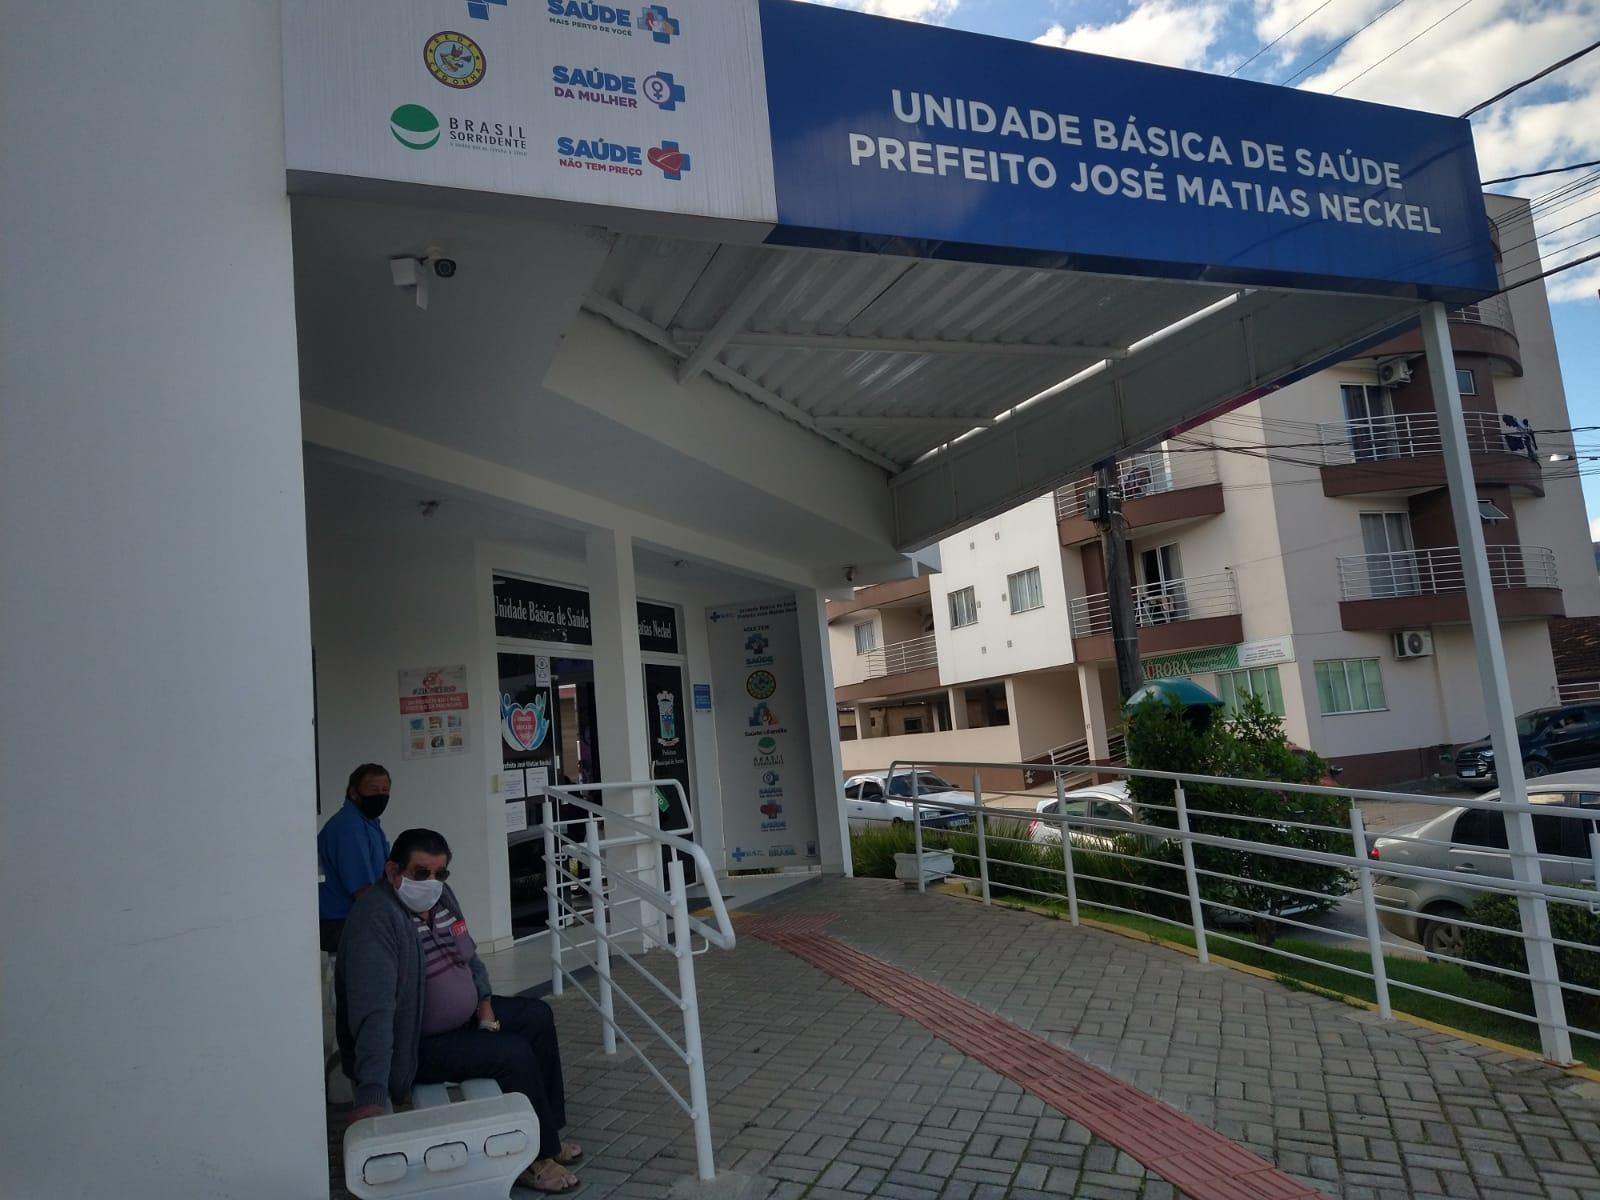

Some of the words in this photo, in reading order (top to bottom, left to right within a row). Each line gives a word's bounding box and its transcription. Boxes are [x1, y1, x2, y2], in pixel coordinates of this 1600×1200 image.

[547, 0, 632, 27] SAÚDE
[549, 17, 570, 26] MAIS
[571, 20, 598, 31] PERTO
[599, 25, 610, 33] DE
[552, 65, 637, 95] SAÚDE
[554, 87, 575, 99] DA
[578, 90, 638, 109] MULHER
[449, 117, 526, 139] BRASIL
[449, 131, 527, 149] SORRIDENTE
[891, 89, 1083, 146] UNIDADE
[1093, 115, 1233, 165] BÁSICA
[1240, 140, 1288, 173] DE
[1295, 148, 1403, 190] SAÚDE
[557, 136, 642, 165] SAÚDE
[559, 158, 582, 168] NÃO
[585, 162, 606, 172] TEM
[609, 165, 643, 176] PREÇO
[849, 133, 1057, 189] PREFEITO
[1070, 162, 1167, 201] JOSÉ
[1176, 174, 1311, 218] MATIAS
[1319, 192, 1441, 234] NECKEL
[529, 601, 555, 624] Básica
[556, 610, 566, 626] de
[567, 607, 589, 629] Saúde
